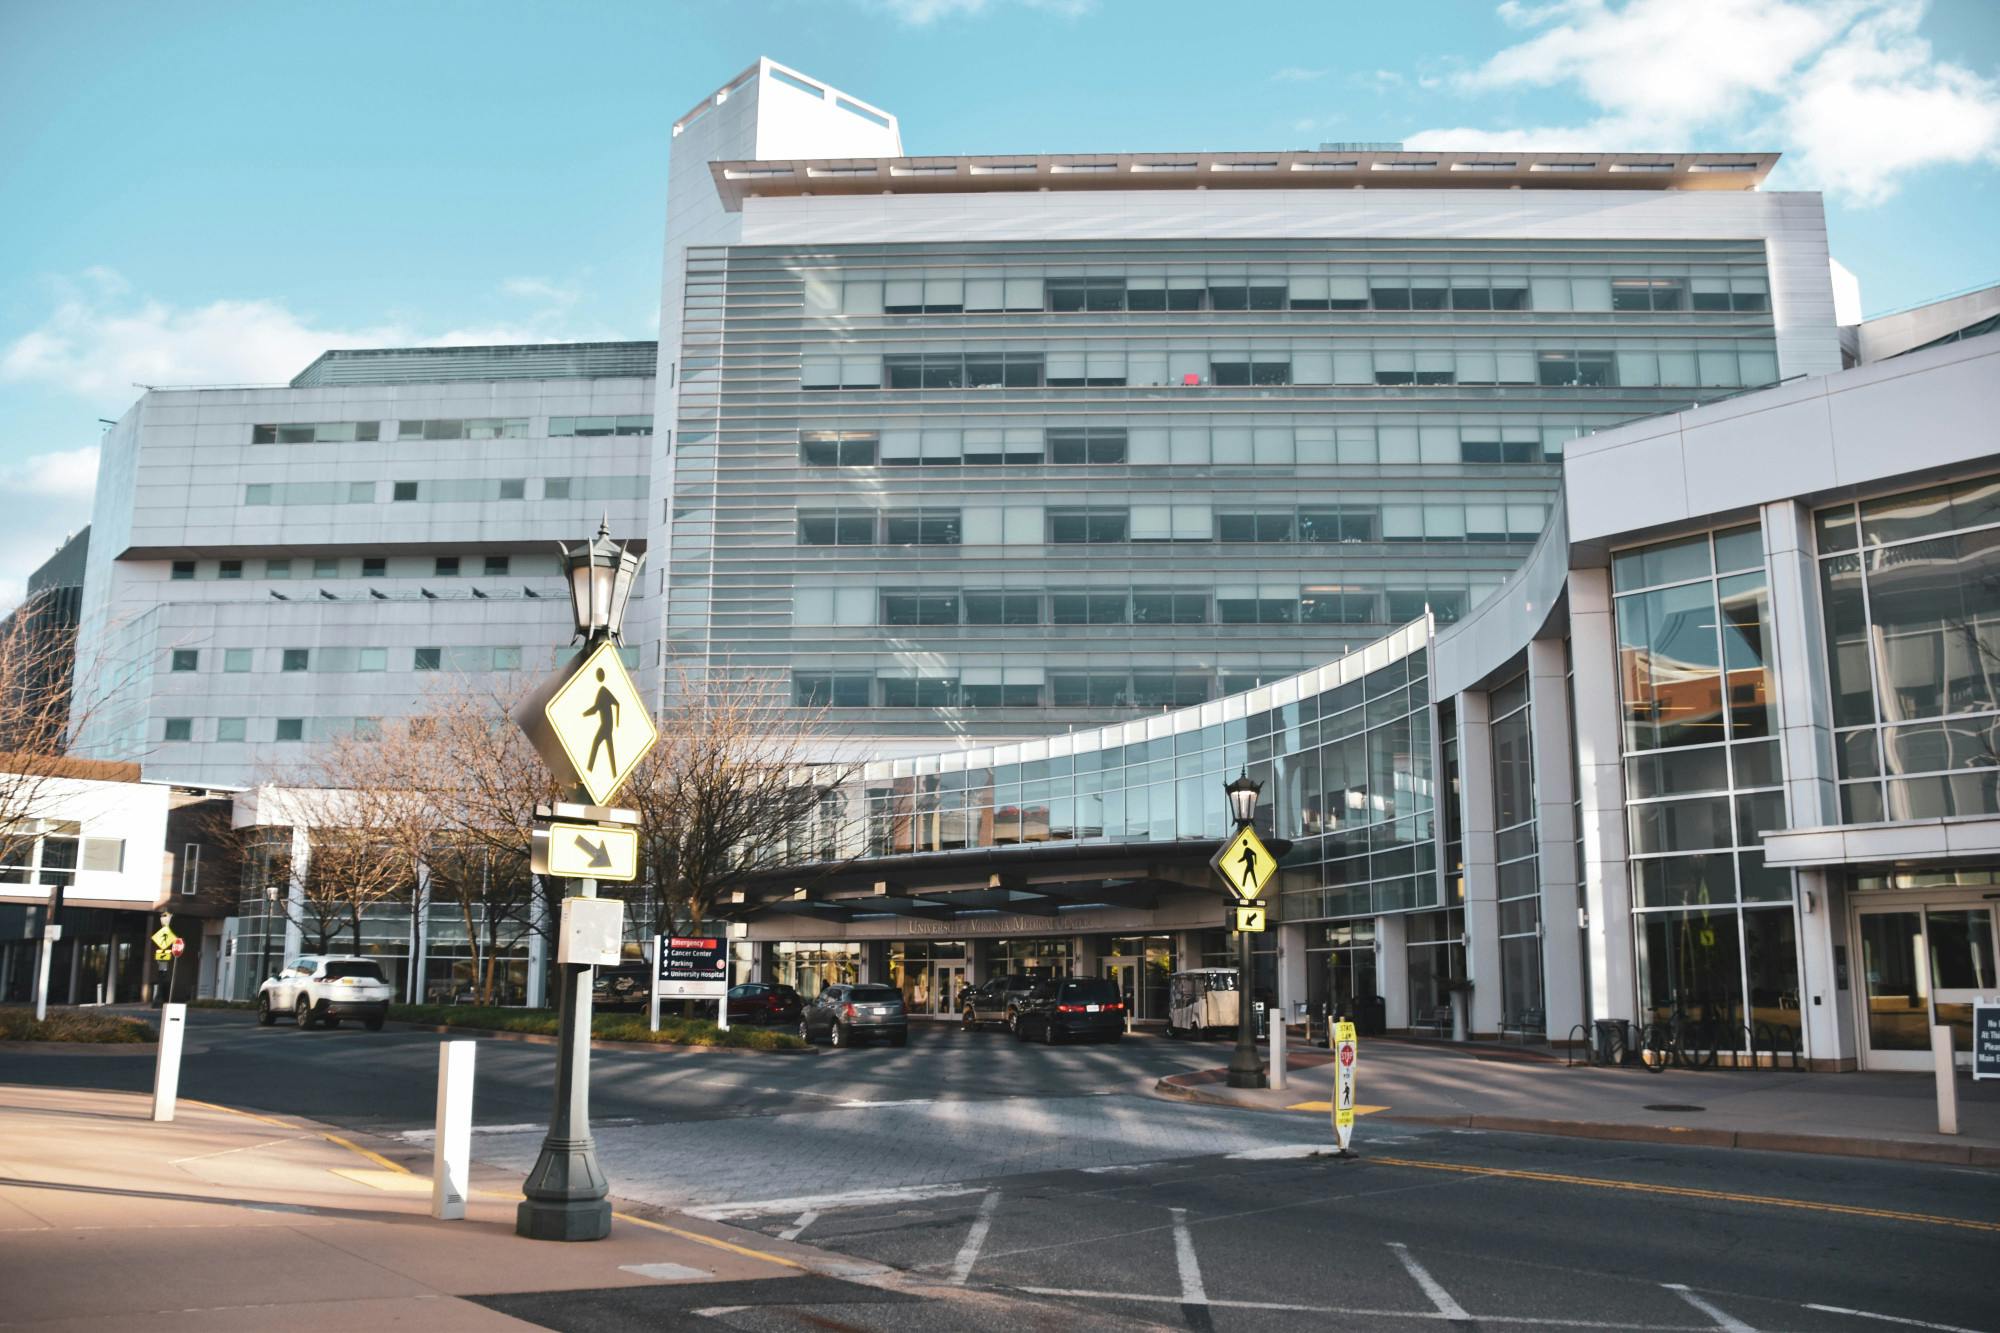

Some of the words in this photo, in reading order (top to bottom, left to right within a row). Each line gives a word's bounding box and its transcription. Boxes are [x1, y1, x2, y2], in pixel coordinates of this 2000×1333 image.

[671, 939, 704, 948] Emergency
[671, 960, 693, 968] Parking
[670, 971, 699, 979] University
[701, 971, 725, 979] Hospital
[1987, 1019, 1997, 1028] No
[1981, 1030, 1990, 1039] At
[1978, 1053, 1995, 1062] Main
